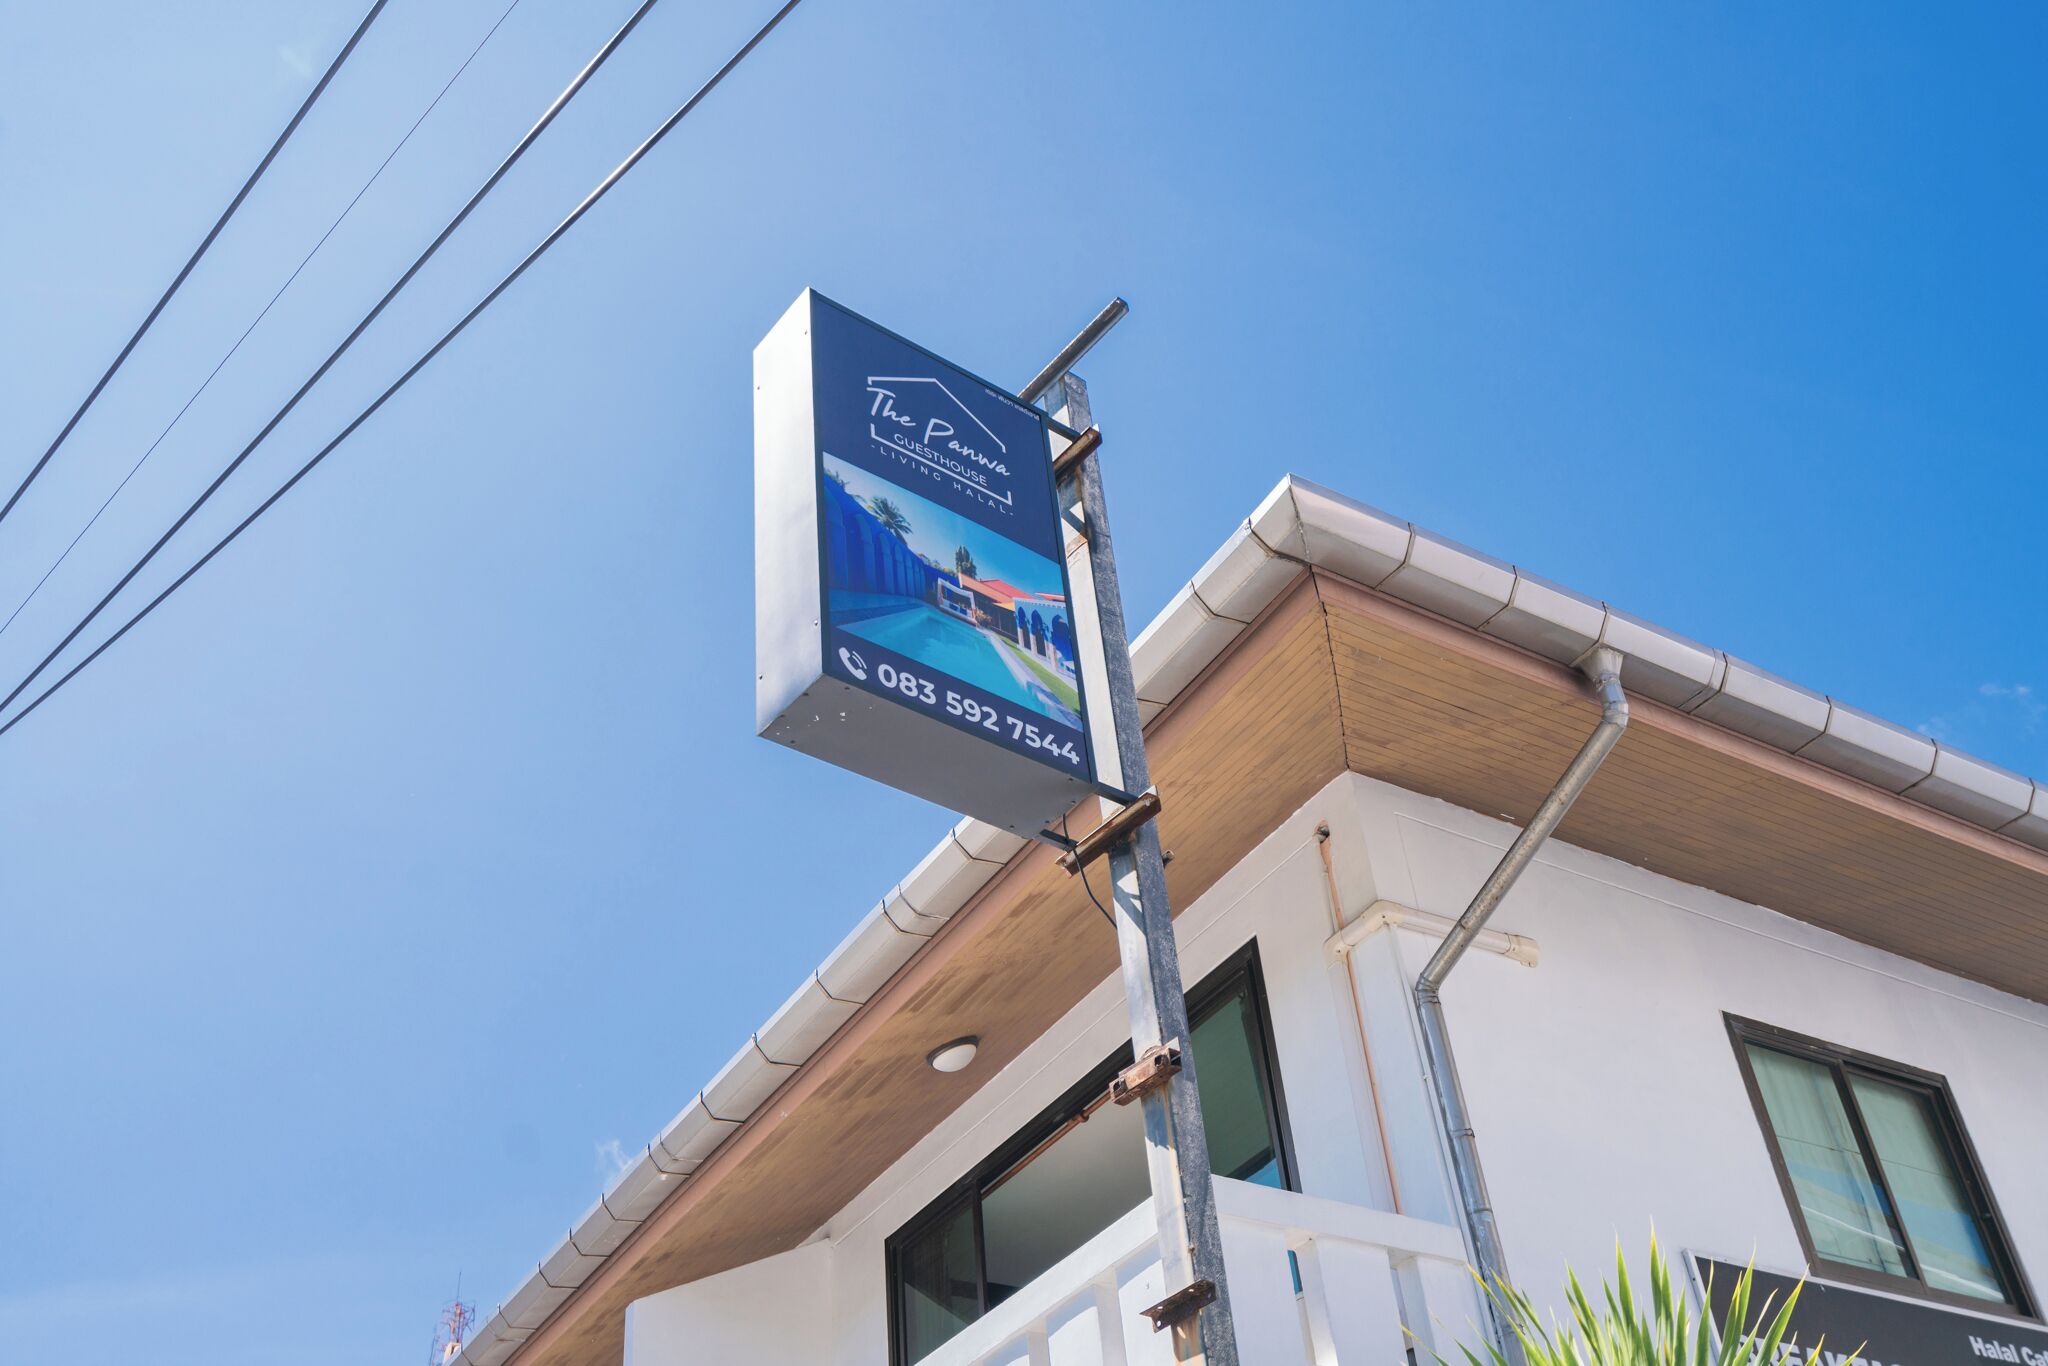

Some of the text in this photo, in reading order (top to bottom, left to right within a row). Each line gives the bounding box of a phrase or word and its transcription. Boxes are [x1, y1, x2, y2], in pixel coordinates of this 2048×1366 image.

[866, 387, 1010, 476] The Panwa
[894, 433, 987, 487] GUESTHOUSE
[877, 663, 1080, 765] 083 592 7544
[1968, 1335, 2020, 1364] Halal
